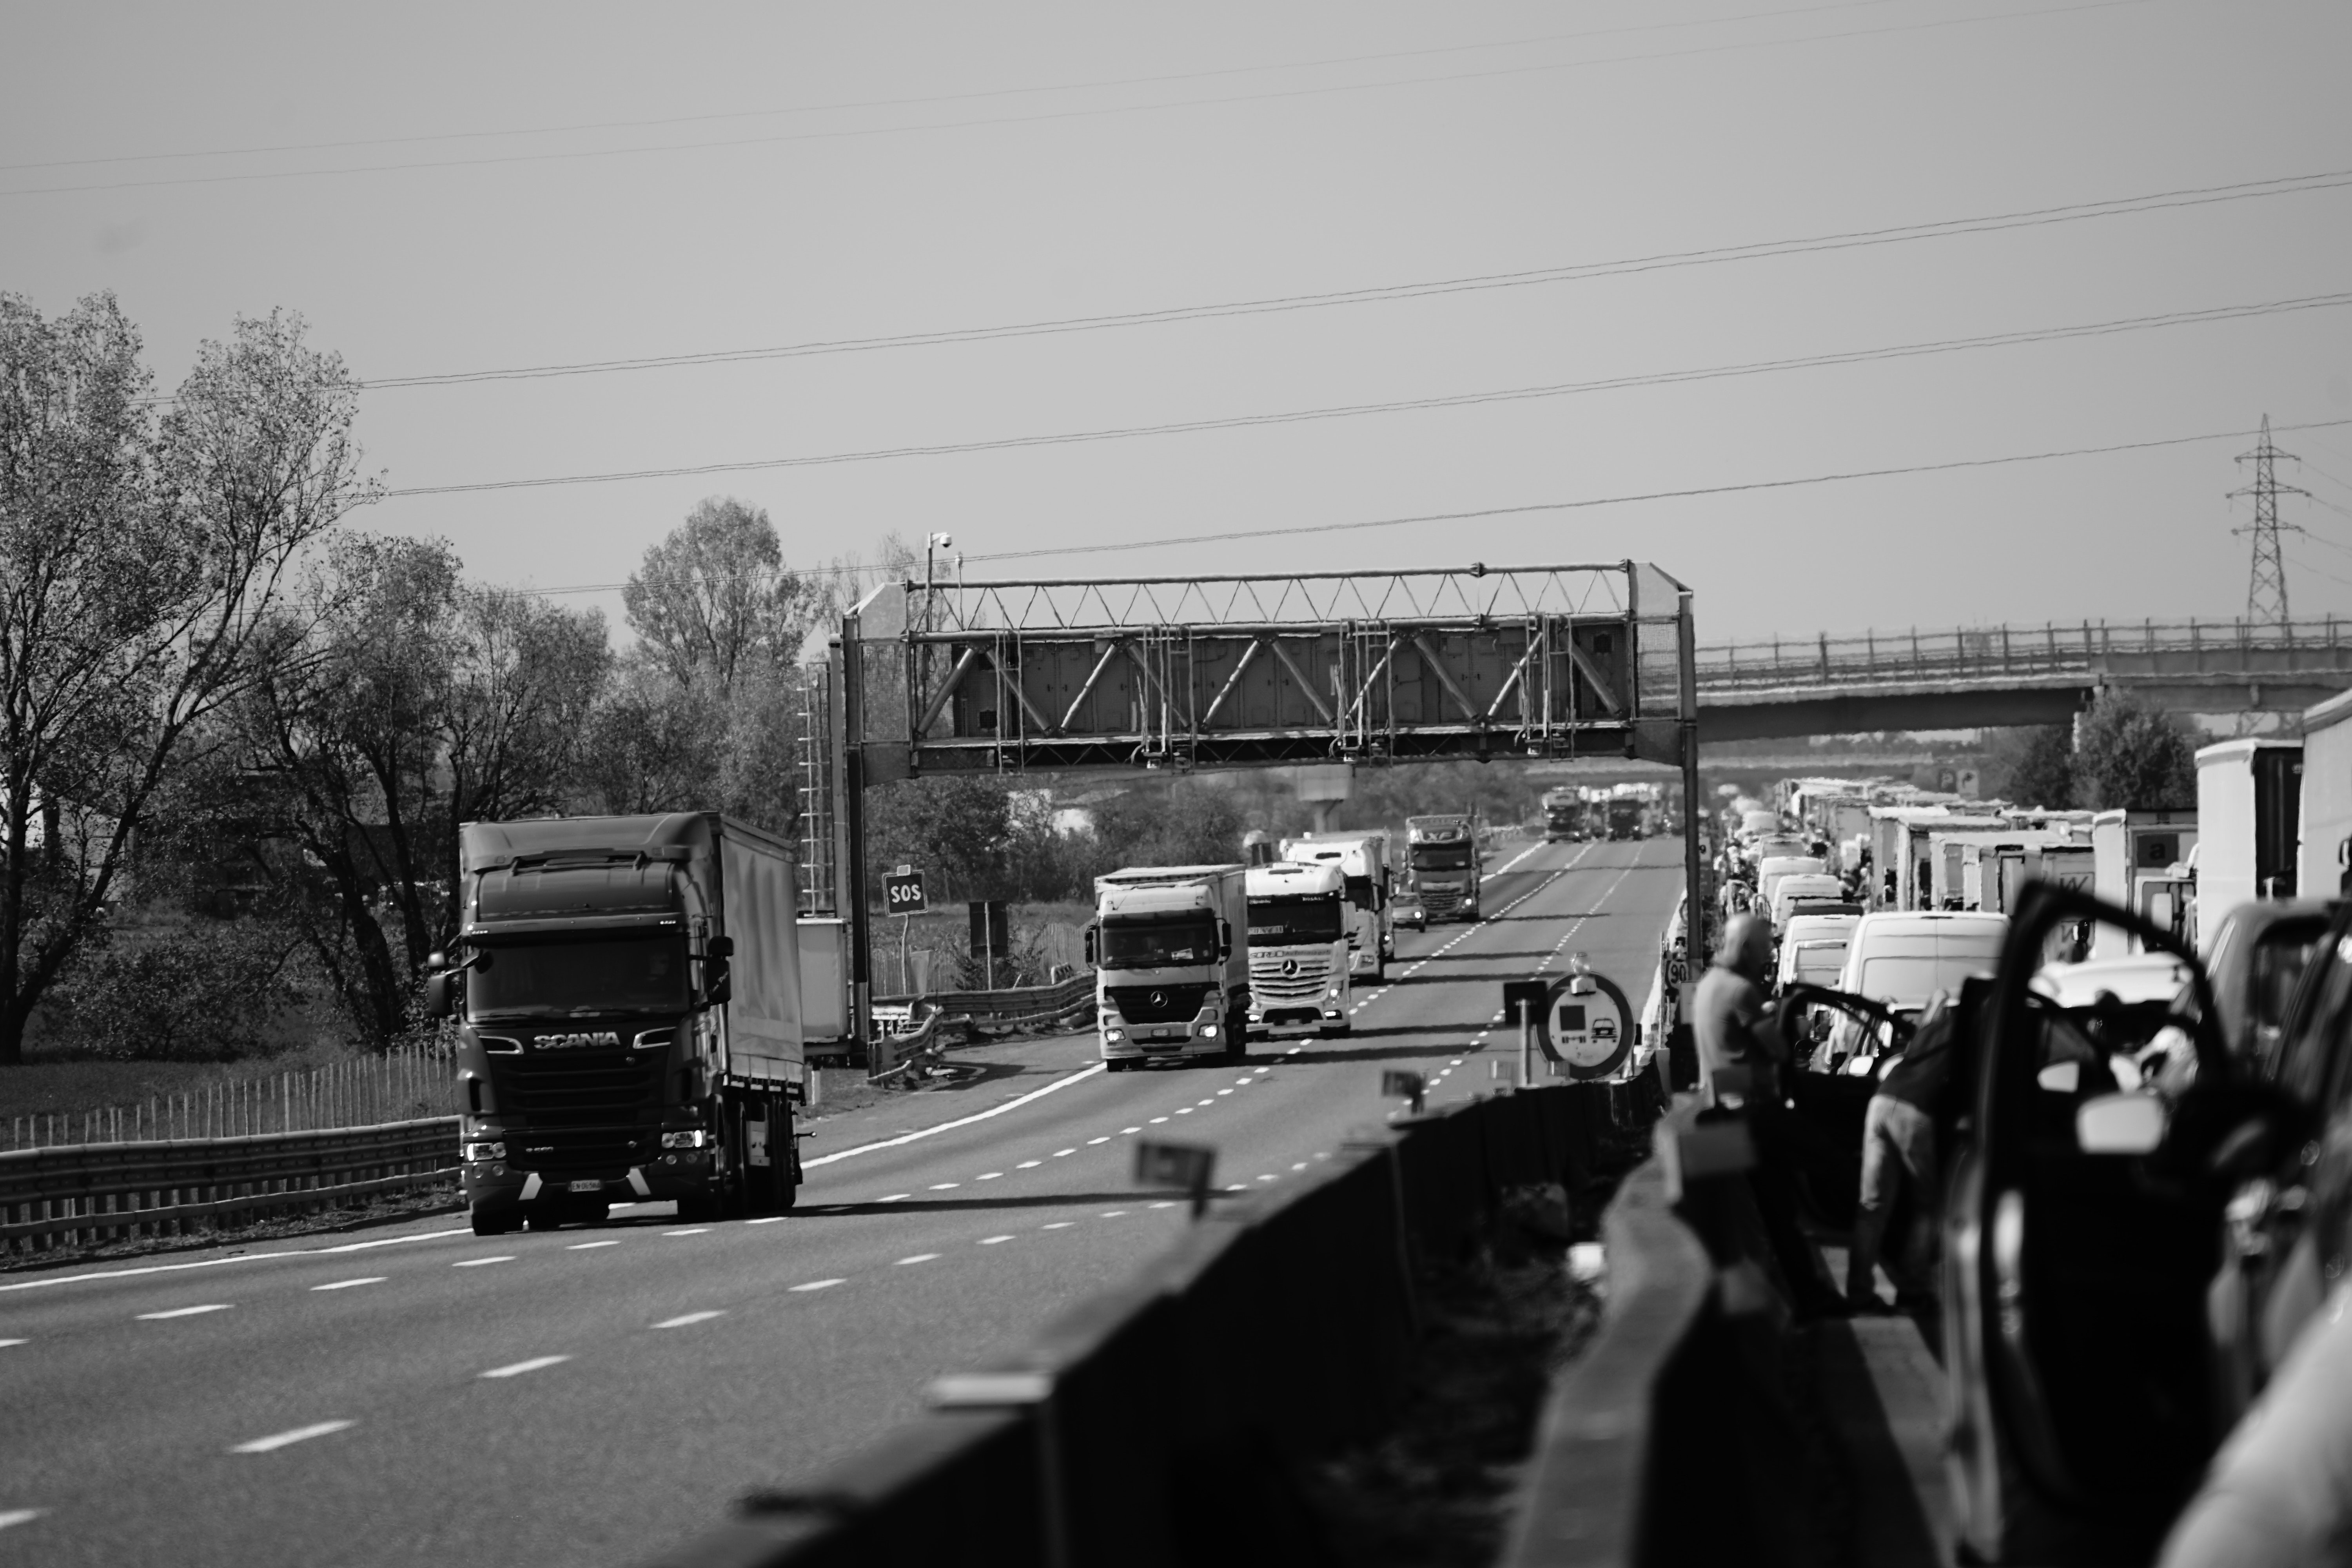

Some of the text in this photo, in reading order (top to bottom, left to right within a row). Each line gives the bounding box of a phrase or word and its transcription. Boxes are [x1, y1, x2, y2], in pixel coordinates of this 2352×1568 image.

[1428, 831, 1452, 840] XF
[891, 884, 921, 903] SOS
[1671, 964, 1686, 984] 90
[534, 1032, 621, 1049] SCANIA
